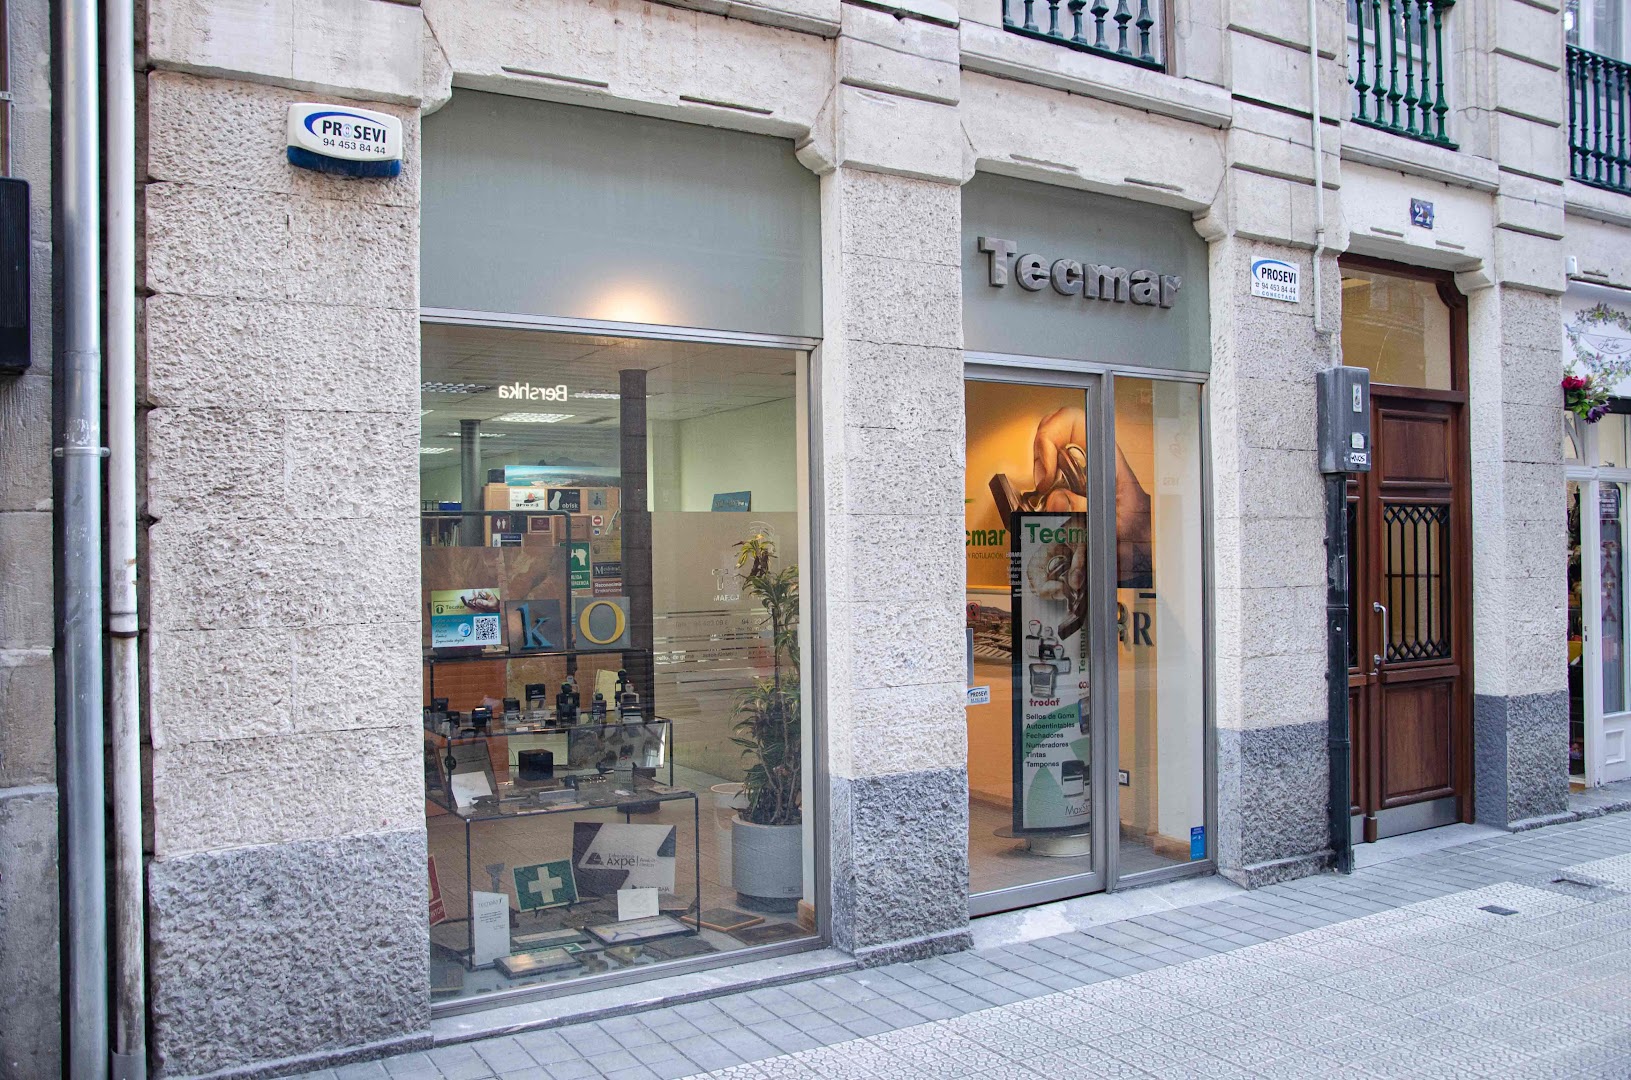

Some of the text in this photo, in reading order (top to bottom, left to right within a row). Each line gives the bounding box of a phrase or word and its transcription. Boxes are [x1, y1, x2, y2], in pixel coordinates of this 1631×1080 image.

[322, 120, 386, 143] PROSEVI
[323, 138, 386, 154] 94 453 84 44
[977, 236, 1182, 308] Tecmar
[1261, 267, 1297, 284] PROSEVI
[1261, 282, 1269, 290] 94
[1270, 283, 1280, 292] 453
[1281, 285, 1288, 293] 84
[1262, 290, 1296, 301] CONECTADA
[966, 529, 1006, 546] cmar
[1024, 523, 1087, 543] Tecm
[580, 600, 626, 645] O
[1078, 625, 1087, 673] Tecmar
[1029, 698, 1060, 707] trodat
[1026, 722, 1075, 730] Autoentintables
[1026, 761, 1060, 769] Tampones
[606, 857, 636, 869] Axpe
